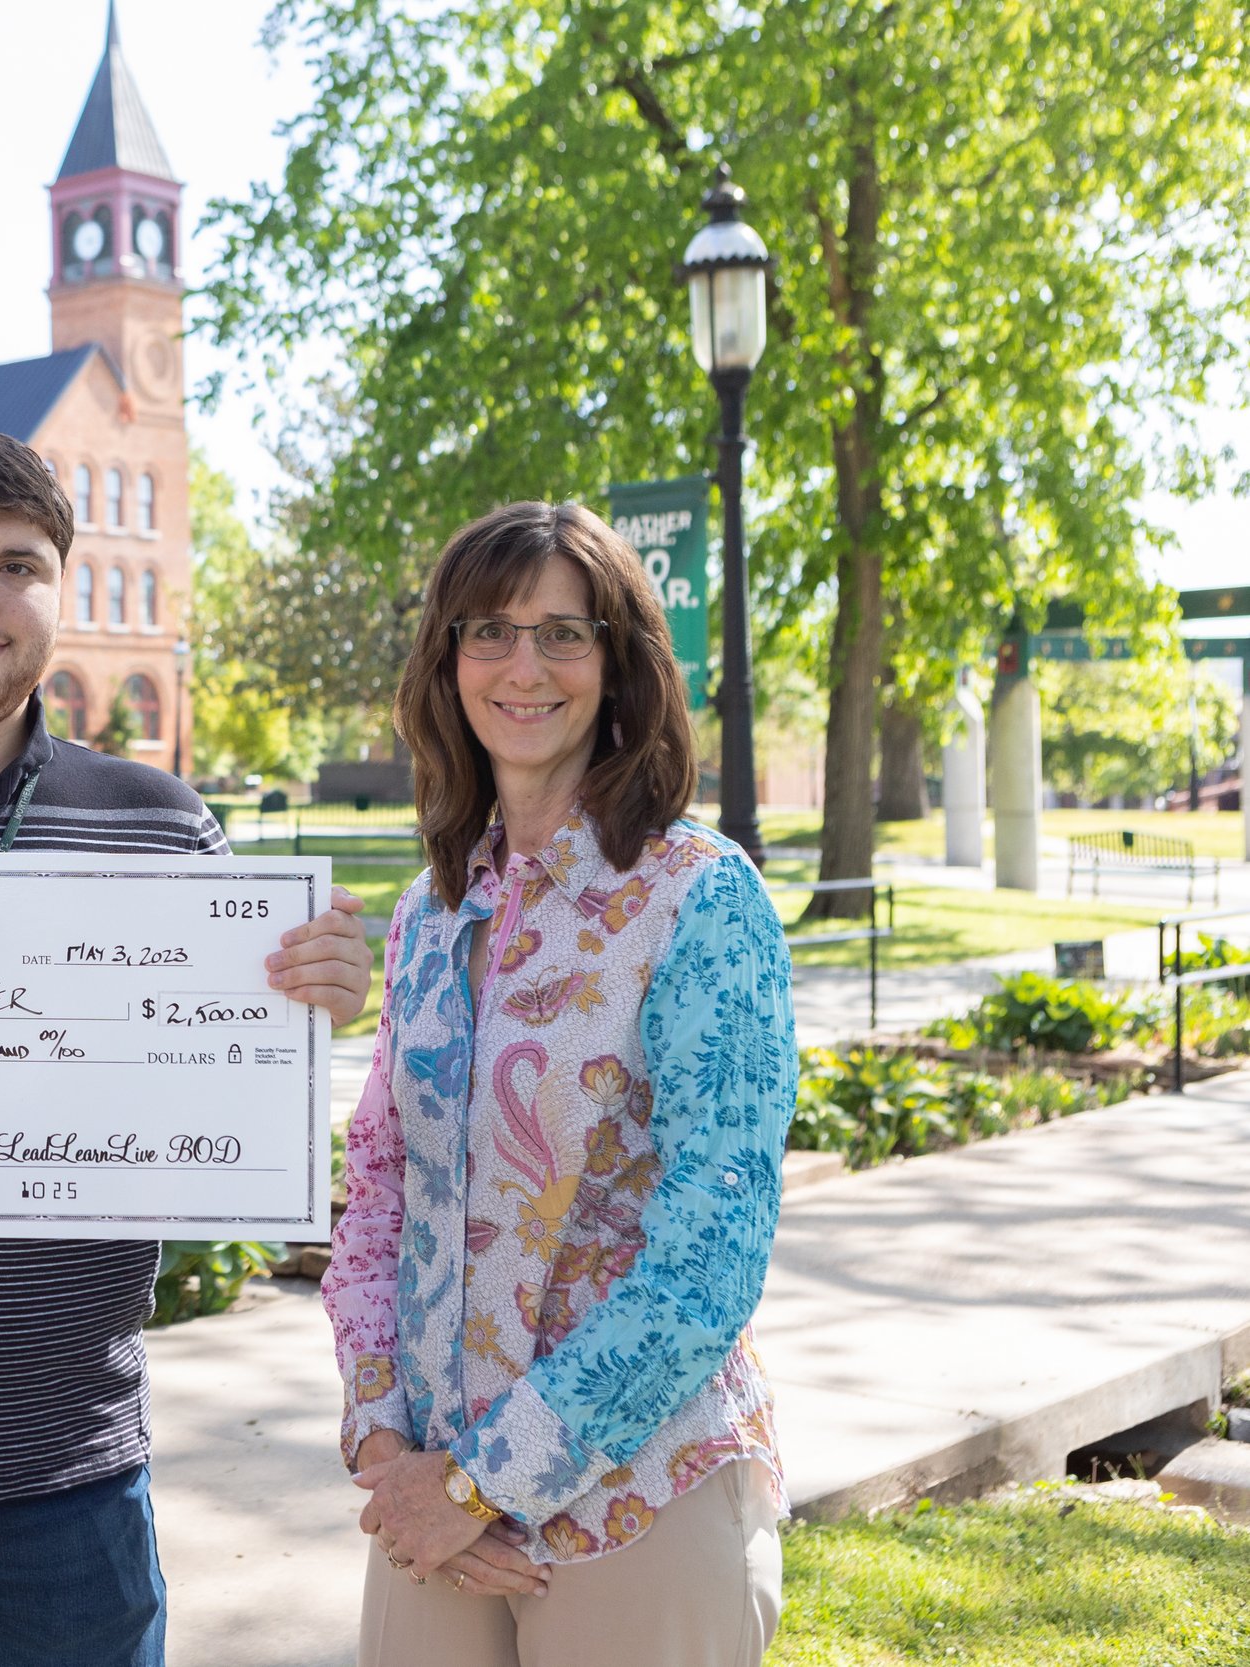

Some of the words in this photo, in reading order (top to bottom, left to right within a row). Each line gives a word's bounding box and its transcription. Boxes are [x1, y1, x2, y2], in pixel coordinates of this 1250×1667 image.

[209, 900, 269, 918] 1025
[22, 954, 52, 965] DATE
[66, 942, 105, 963] MAY
[112, 945, 132, 966] 3,
[139, 947, 189, 966] 2023
[141, 998, 156, 1019] $
[166, 1001, 269, 1027] 2,500.00
[147, 1052, 216, 1065] DOLLARS
[166, 1134, 241, 1164] BOD
